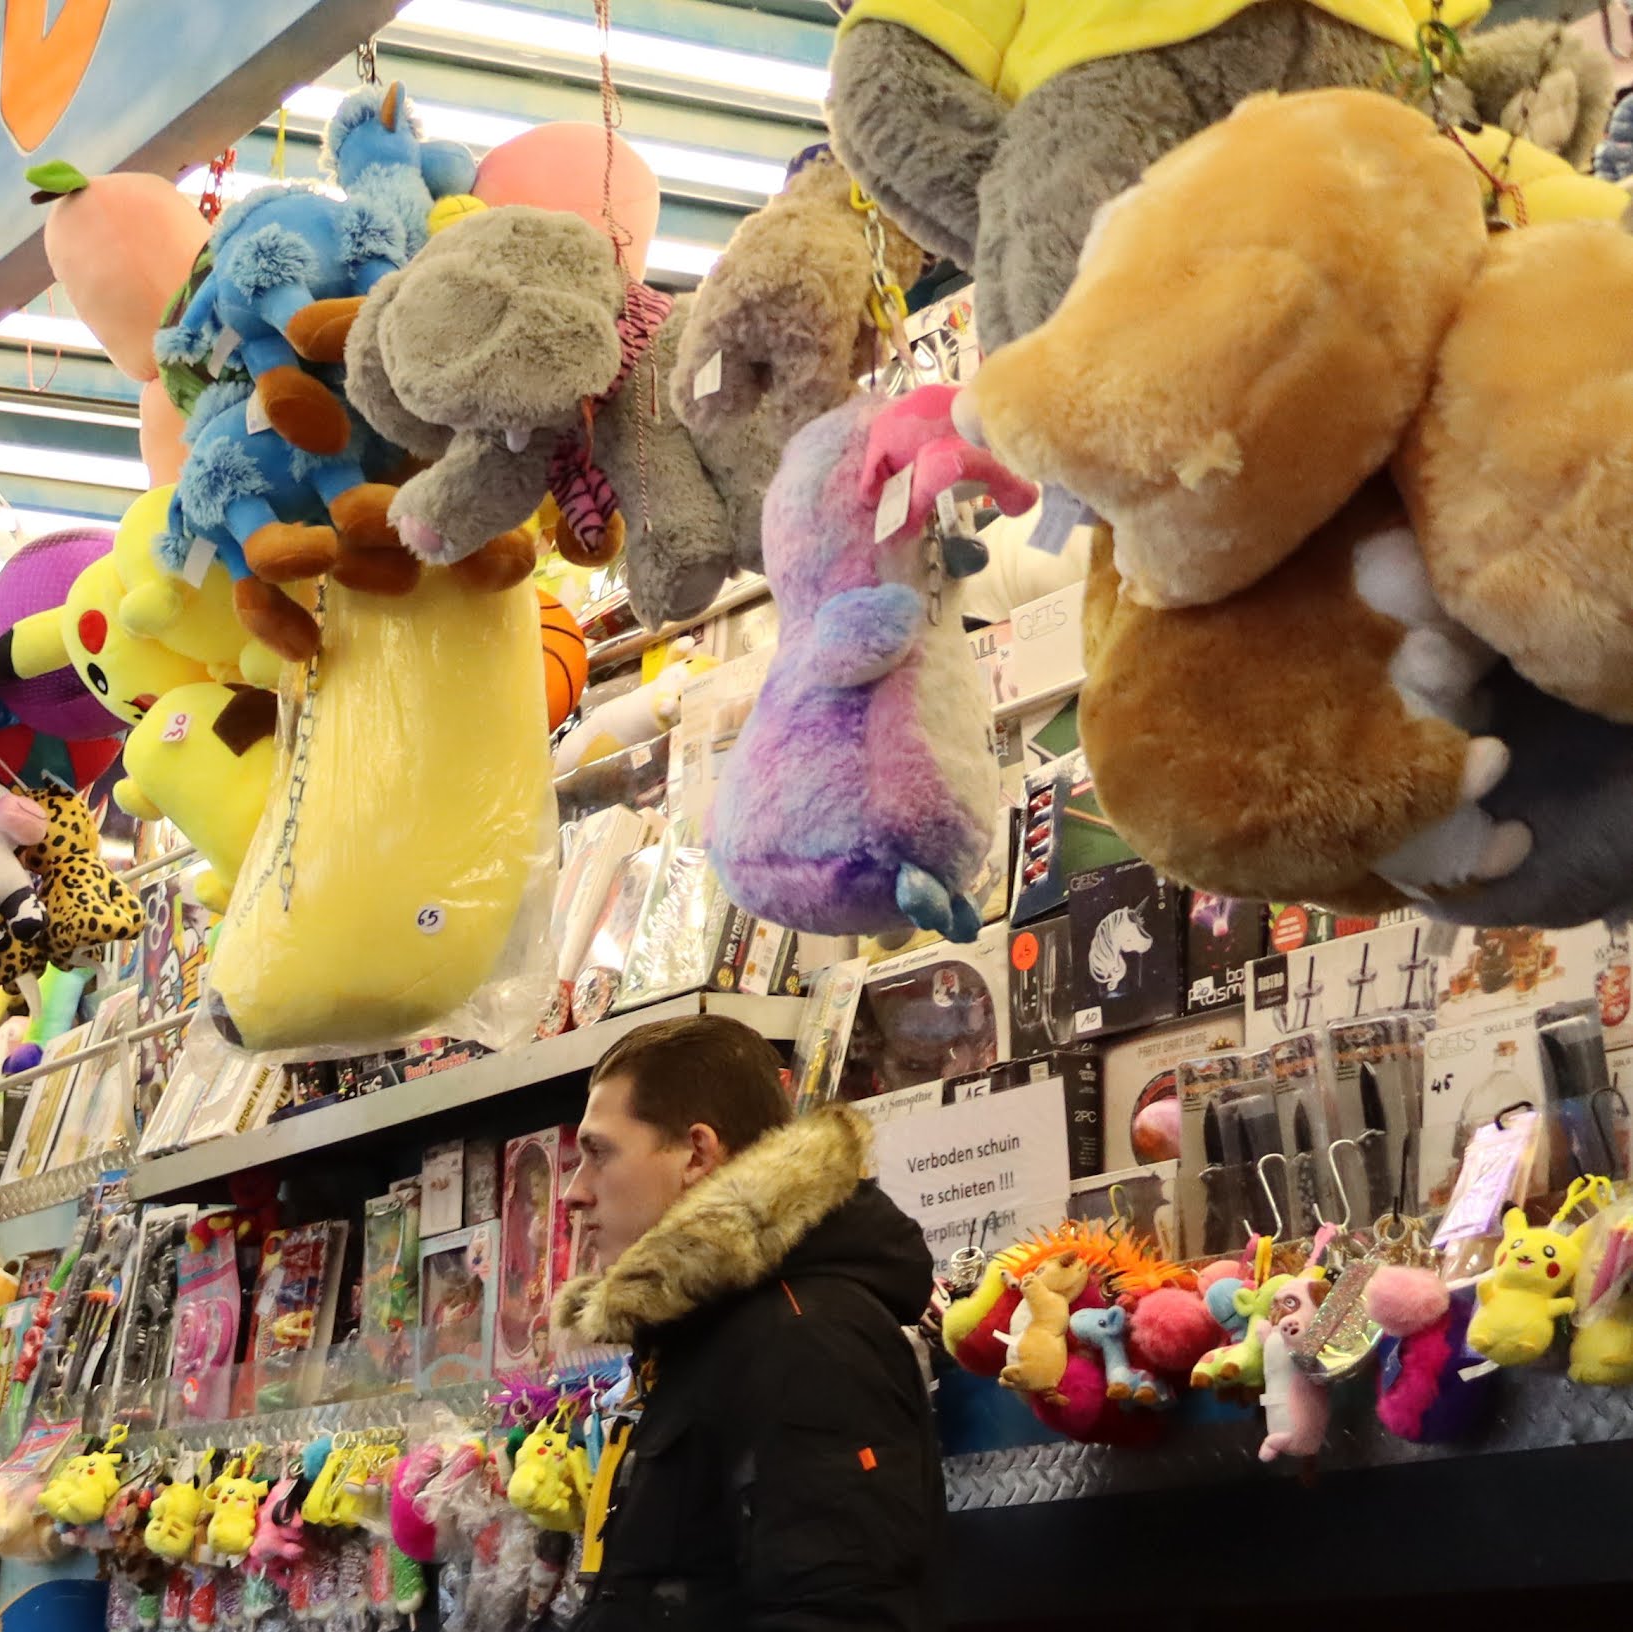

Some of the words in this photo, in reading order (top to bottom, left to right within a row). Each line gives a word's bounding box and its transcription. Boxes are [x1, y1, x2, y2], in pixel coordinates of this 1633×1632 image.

[1017, 600, 1068, 641] GIFTS
[1069, 872, 1103, 892] GIFTS
[1427, 1028, 1477, 1060] GIFTS
[907, 1147, 974, 1174] Verboden
[977, 1134, 1021, 1157] schuin
[920, 1192, 934, 1208] te
[938, 1177, 996, 1204] schieten
